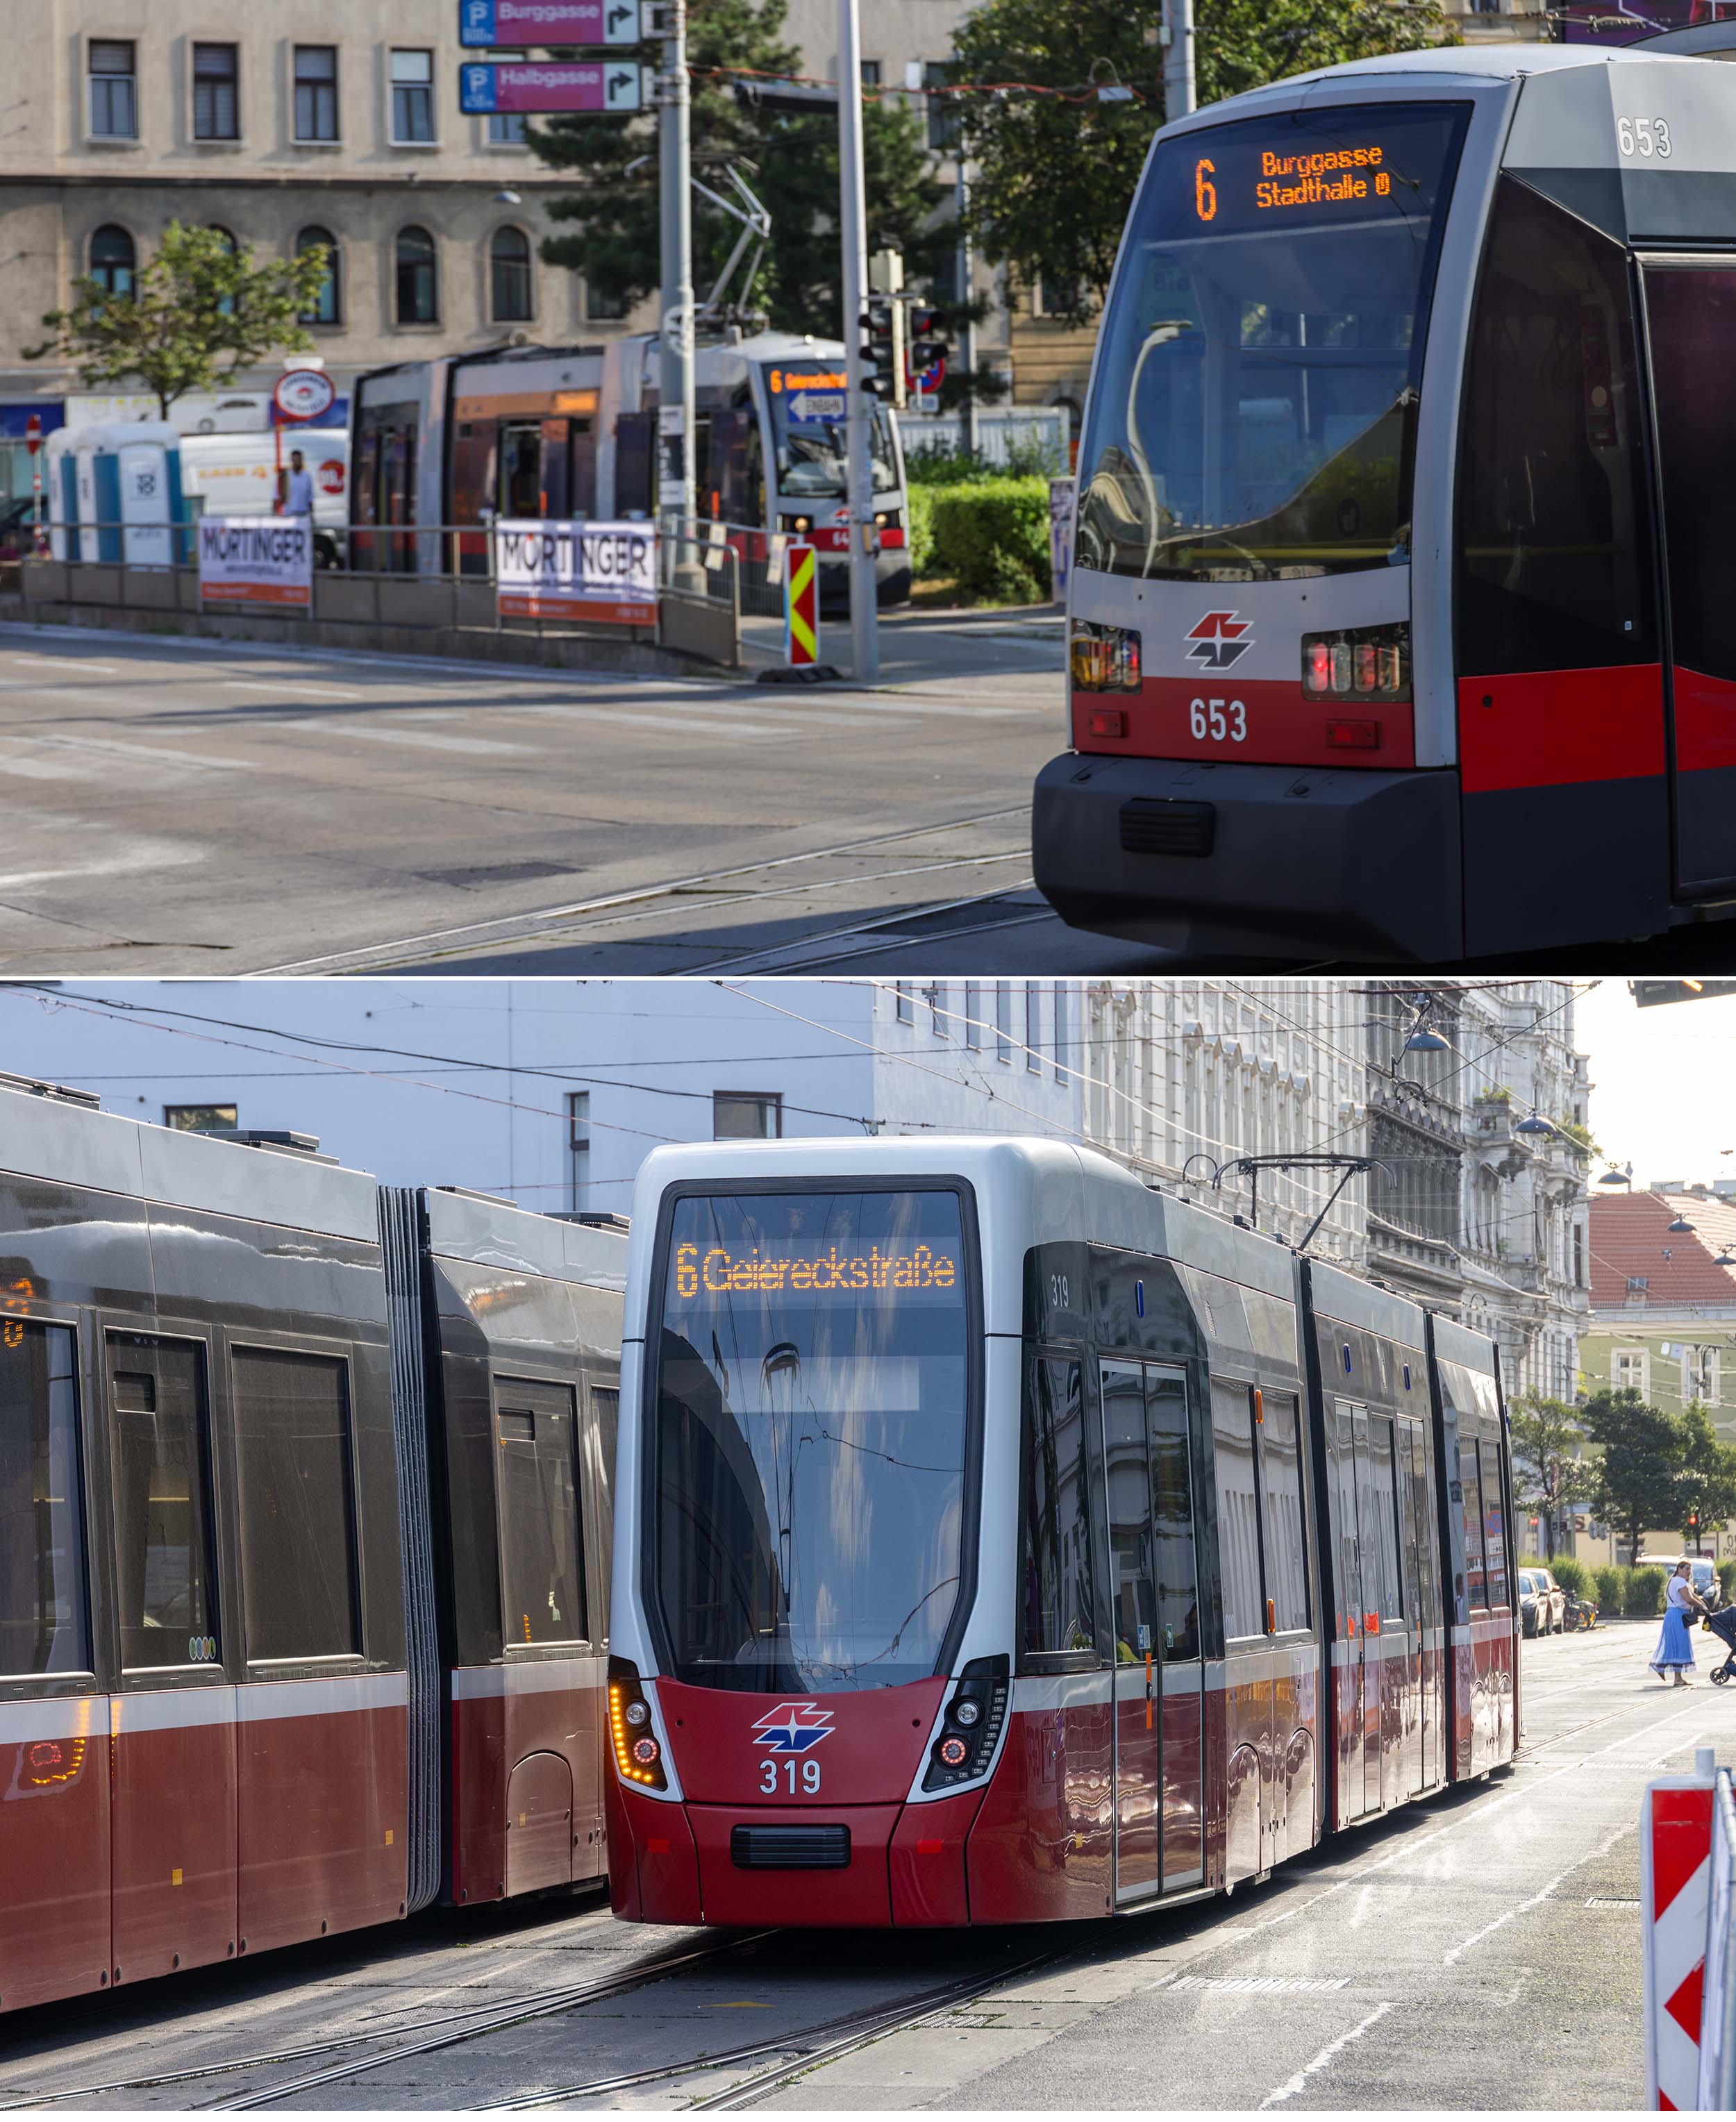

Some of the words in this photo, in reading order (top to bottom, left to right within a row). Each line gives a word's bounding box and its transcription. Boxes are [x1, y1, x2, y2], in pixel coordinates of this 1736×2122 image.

[499, 3, 600, 22] Burggasse
[500, 69, 600, 87] Halbgasse
[1617, 116, 1673, 159] 653
[1261, 147, 1383, 177] Burggasse
[1195, 159, 1217, 221] 6
[1256, 174, 1367, 208] Stadthalle
[770, 369, 783, 394] 6
[833, 530, 849, 546] 64
[1189, 698, 1248, 742] 653
[677, 1243, 698, 1297] 6
[702, 1245, 955, 1291] Geiereckstraße
[1051, 1273, 1069, 1308] 319
[759, 1759, 821, 1795] 319
